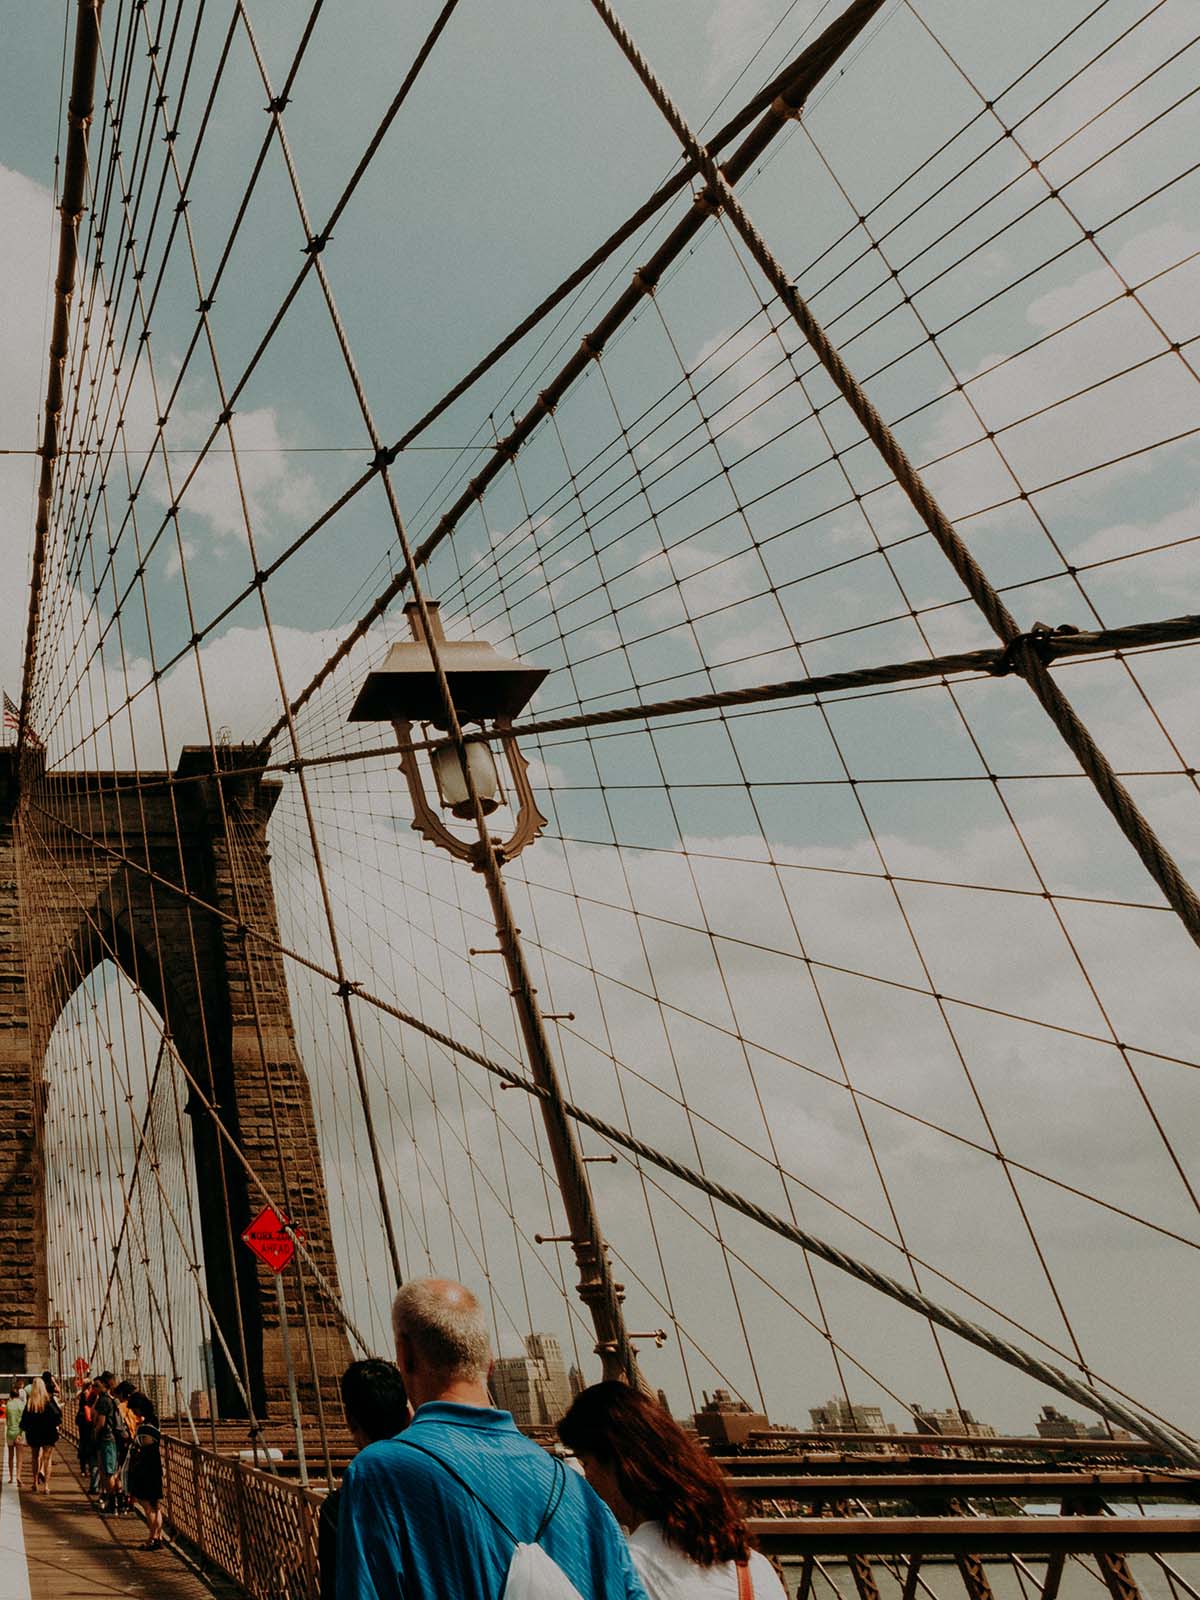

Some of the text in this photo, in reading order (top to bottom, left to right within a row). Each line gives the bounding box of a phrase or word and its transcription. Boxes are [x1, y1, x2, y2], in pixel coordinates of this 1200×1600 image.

[251, 1232, 293, 1241] WORK ZON
[262, 1243, 290, 1254] AHEAD
